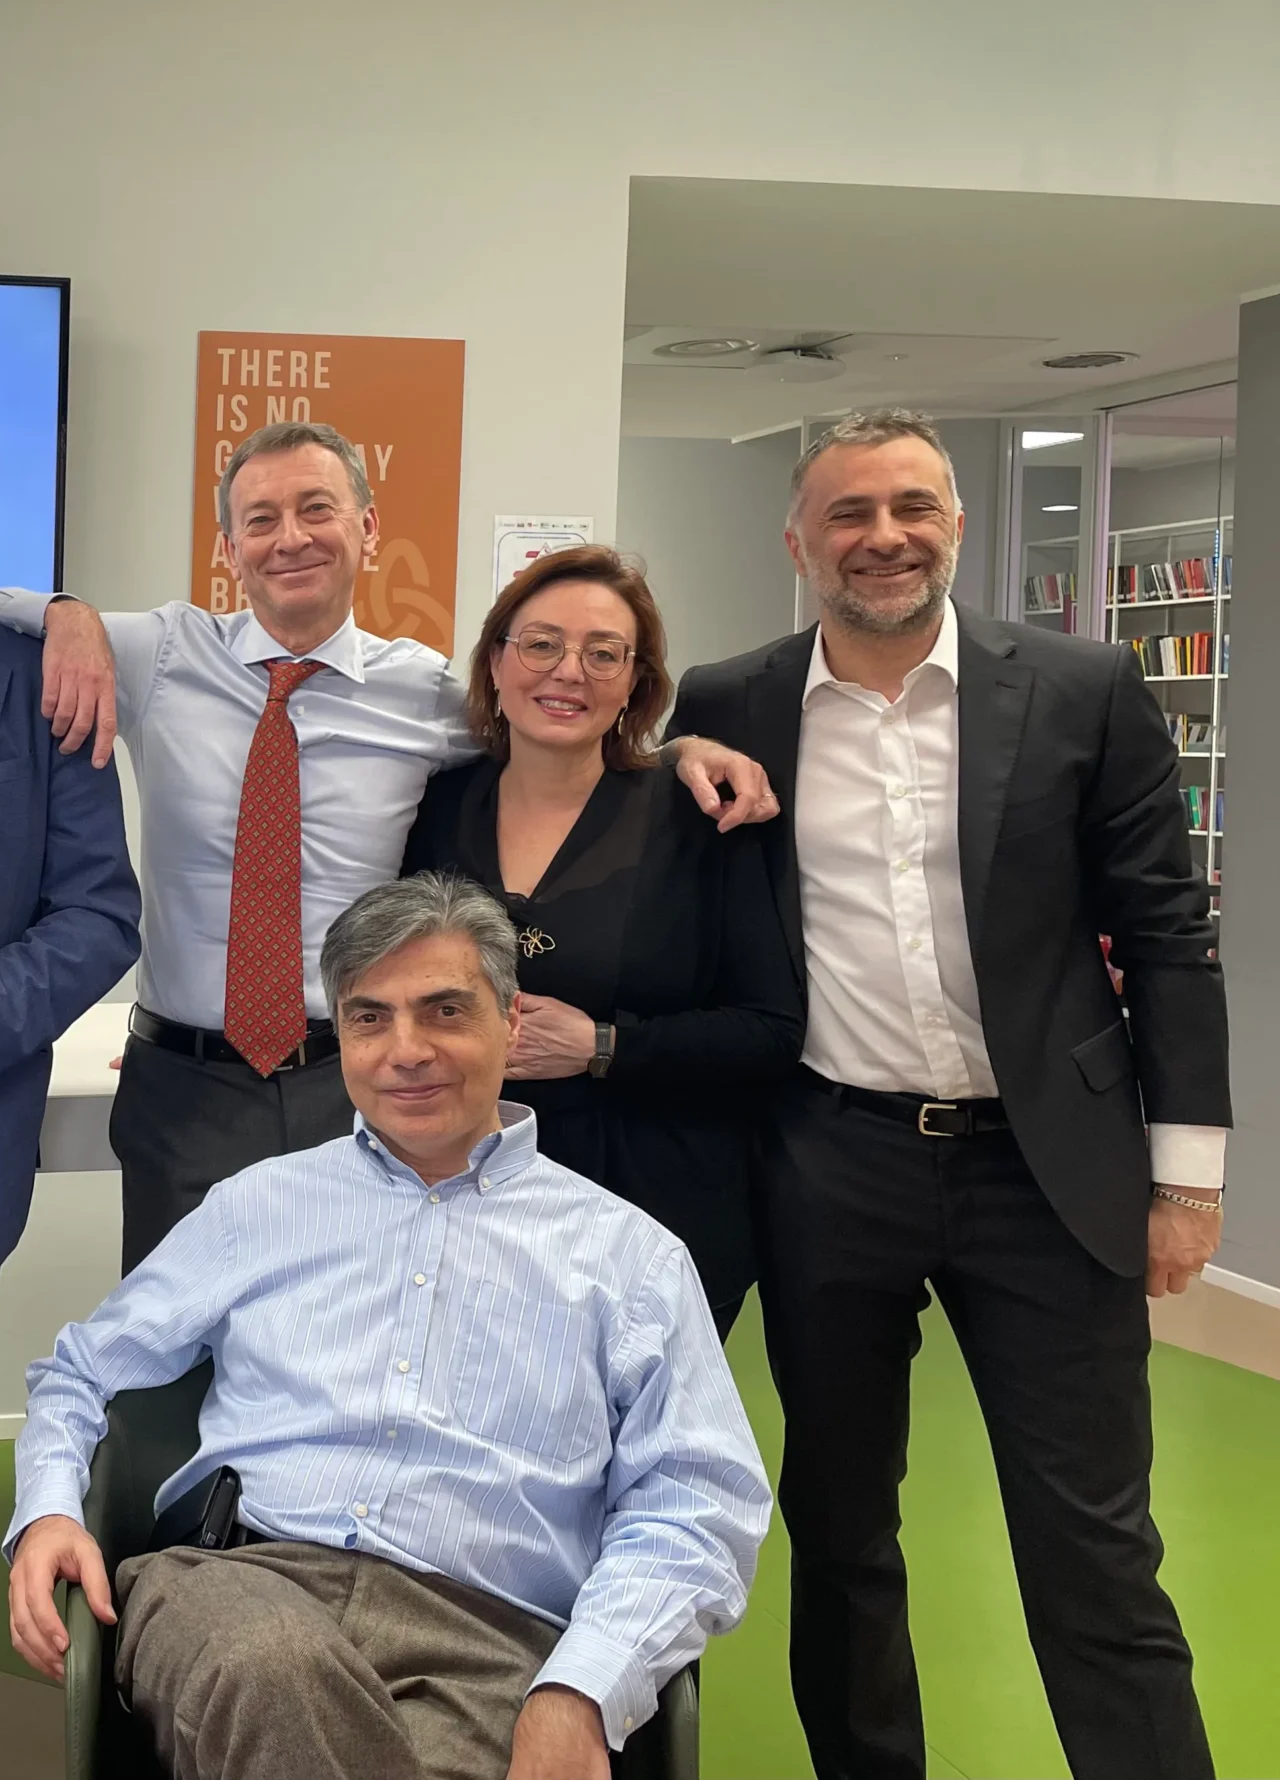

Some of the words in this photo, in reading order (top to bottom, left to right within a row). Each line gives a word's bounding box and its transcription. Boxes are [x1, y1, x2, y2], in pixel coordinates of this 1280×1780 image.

[217, 348, 331, 388] THERE
[216, 394, 248, 432] IS
[266, 395, 310, 426] NO
